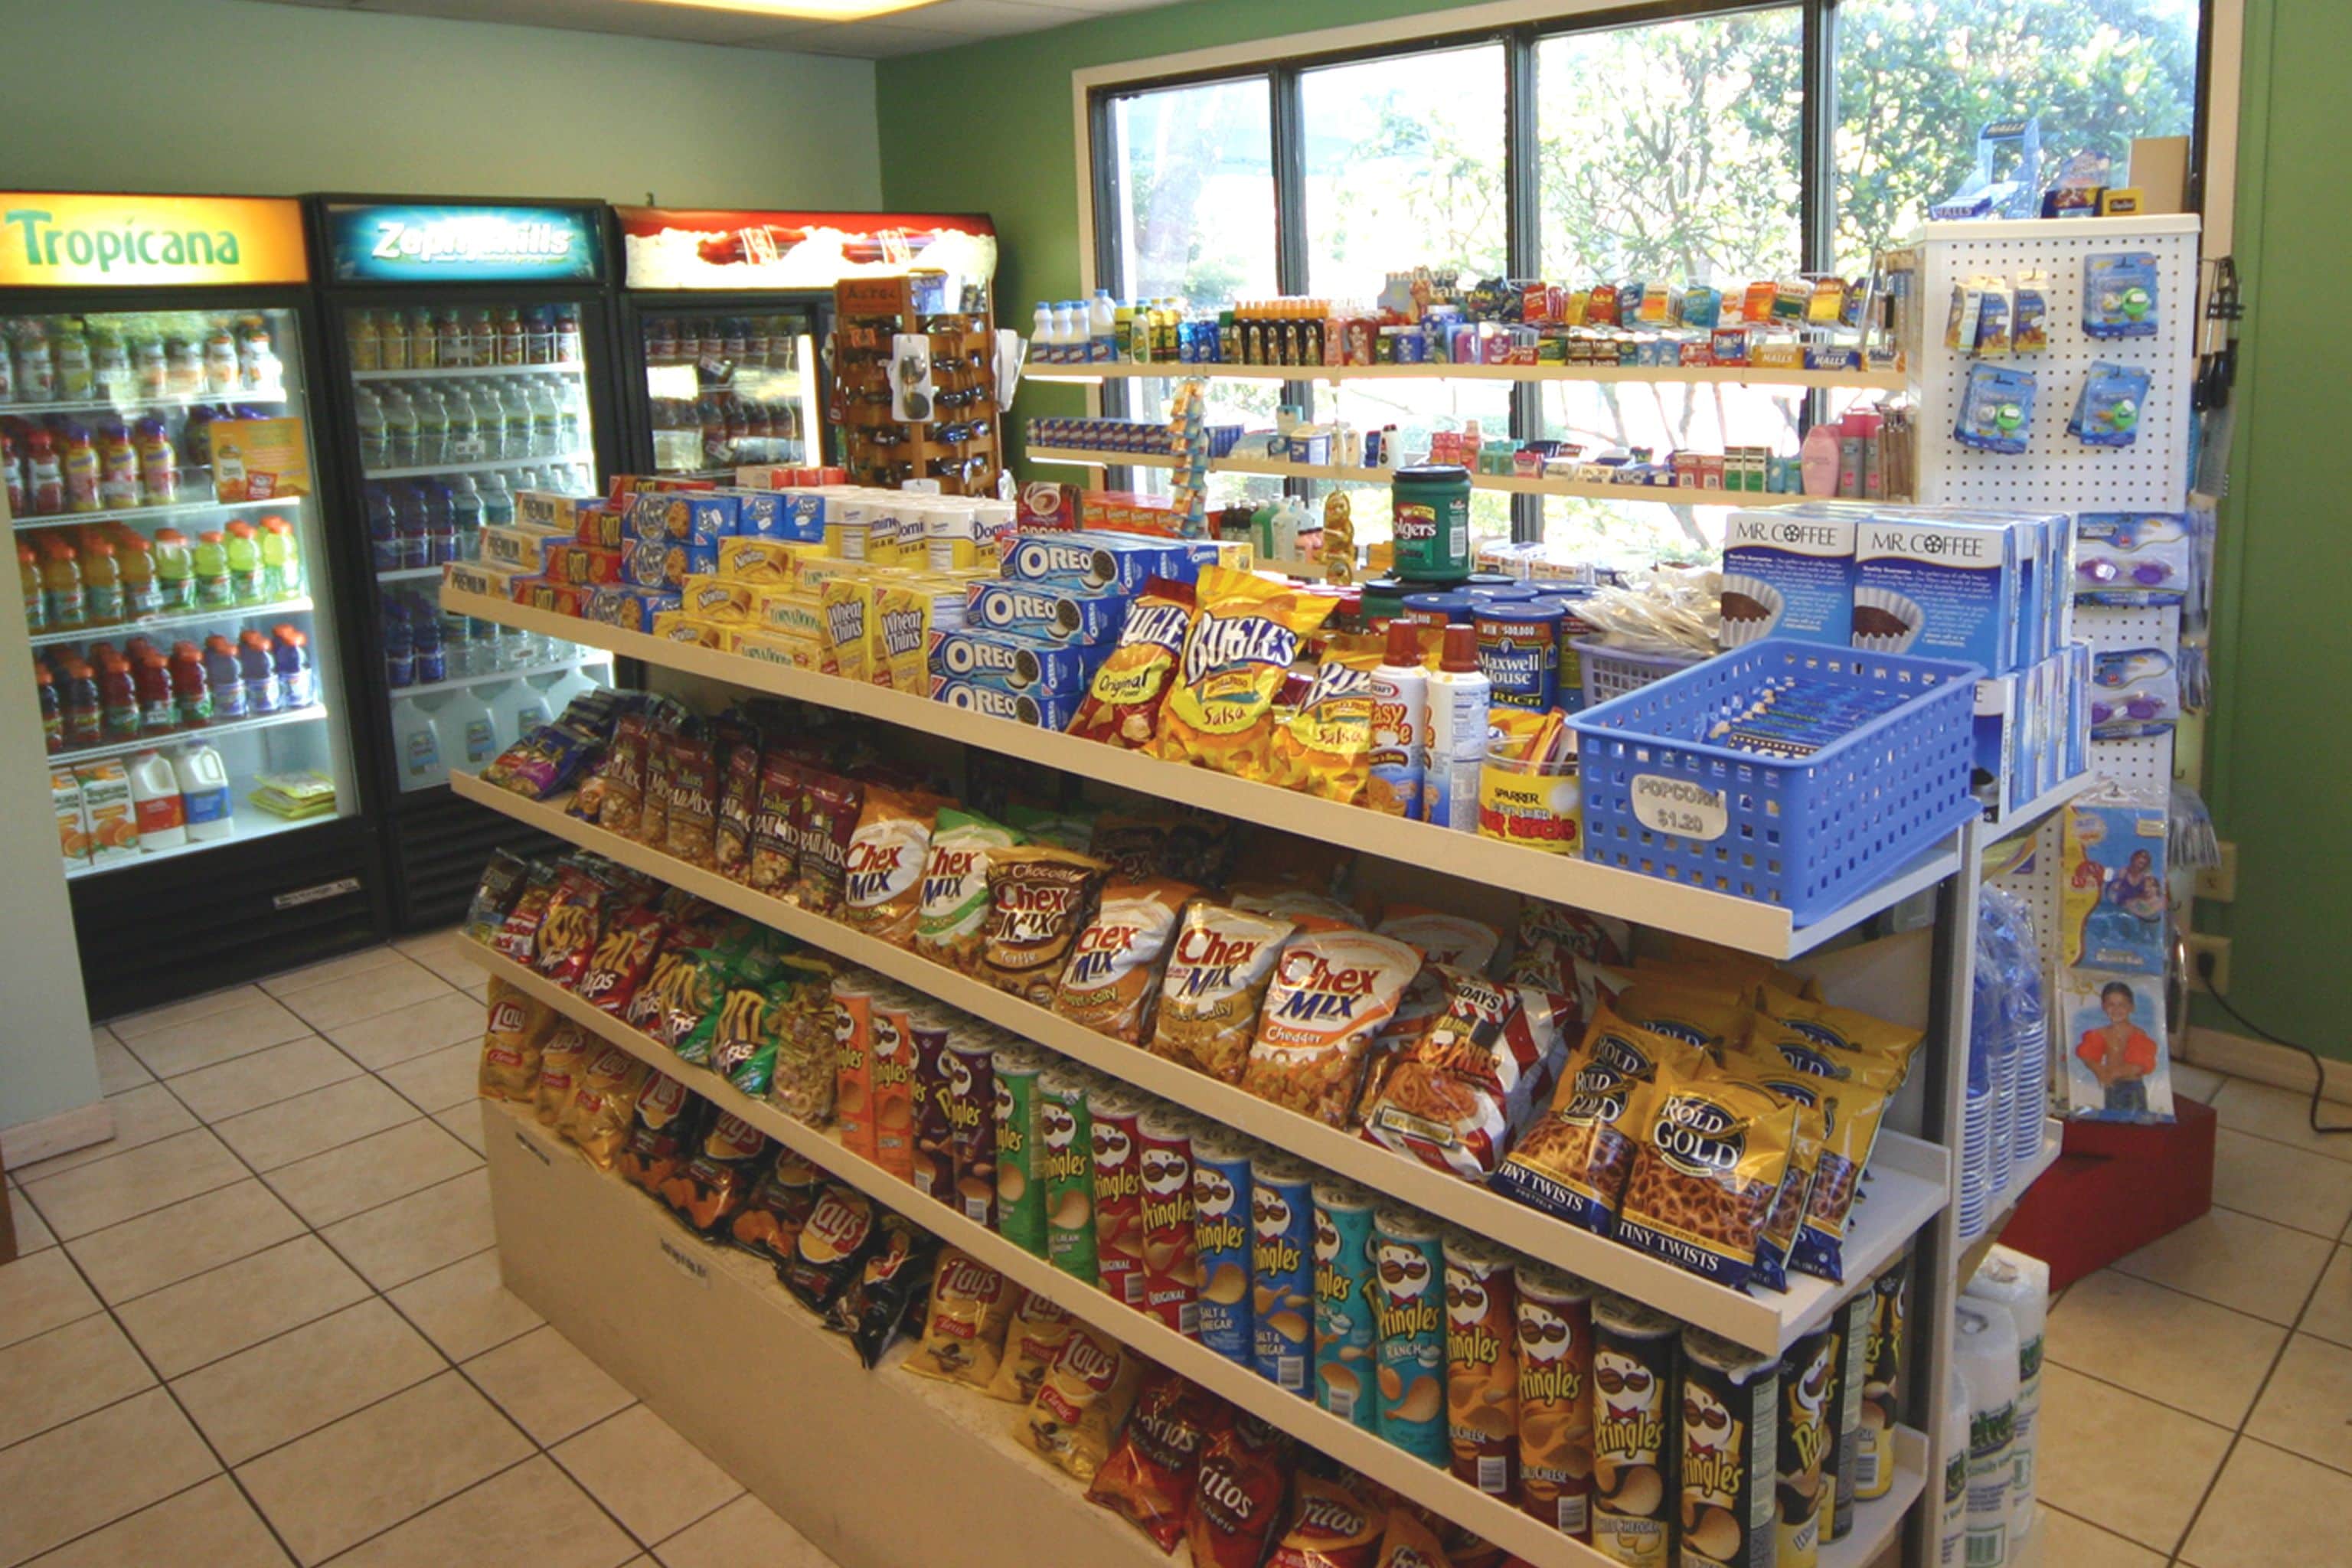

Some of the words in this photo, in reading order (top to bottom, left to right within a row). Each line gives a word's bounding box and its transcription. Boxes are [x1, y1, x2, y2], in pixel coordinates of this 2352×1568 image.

[5, 209, 240, 272] Tropicana
[1772, 524, 1838, 546] COFFEE
[1911, 534, 1984, 558] COFFEE
[1020, 544, 1093, 577] OREO
[826, 599, 864, 625] Wheat
[882, 609, 923, 636] Wheat
[985, 590, 1057, 626] OREO
[831, 621, 863, 645] Thins
[887, 631, 922, 655] Thins
[946, 640, 1017, 674] OREO
[1185, 611, 1298, 690] BUGLES
[1478, 653, 1539, 671] Maxwell
[1099, 671, 1150, 697] Original
[1494, 691, 1542, 706] RICH
[947, 684, 1017, 717] OREO
[1204, 706, 1246, 726] Salsa
[1373, 704, 1406, 726] asy
[1315, 722, 1366, 744] Salsa
[1657, 808, 1704, 833] $1.20
[845, 842, 903, 872] Chex
[848, 868, 893, 901] MIX
[923, 877, 966, 909] MIX
[997, 882, 1069, 911] Chex
[998, 911, 1060, 942] MIX
[1177, 927, 1263, 965] Chex
[1070, 948, 1122, 985] MIX
[1177, 965, 1237, 997] MIX
[1278, 950, 1381, 994] Chex
[490, 1003, 525, 1032] Lay
[1276, 991, 1361, 1021] MIX
[1266, 1026, 1322, 1044] Cheddar
[1599, 1036, 1638, 1073] ROLD
[1785, 1051, 1824, 1076] OLD
[1576, 1070, 1611, 1092] ROLD
[1565, 1093, 1619, 1122] GOLD
[1661, 1096, 1723, 1133] ROLD
[1654, 1119, 1738, 1169] GOLD
[1046, 1148, 1087, 1183] ingles
[1096, 1167, 1141, 1203] ringles
[1498, 1162, 1530, 1184] TINY
[1532, 1171, 1584, 1213] TWISTS
[1197, 1217, 1246, 1254] ringles
[1619, 1221, 1655, 1247] TINY
[1658, 1235, 1720, 1272] TWISTS
[1254, 1239, 1302, 1277] ingles
[1380, 1297, 1440, 1340] Pringles
[1385, 1343, 1422, 1361] RANCH
[1448, 1328, 1501, 1369] ingles
[1685, 1452, 1745, 1498] ringles
[1198, 1464, 1253, 1519] ritos
